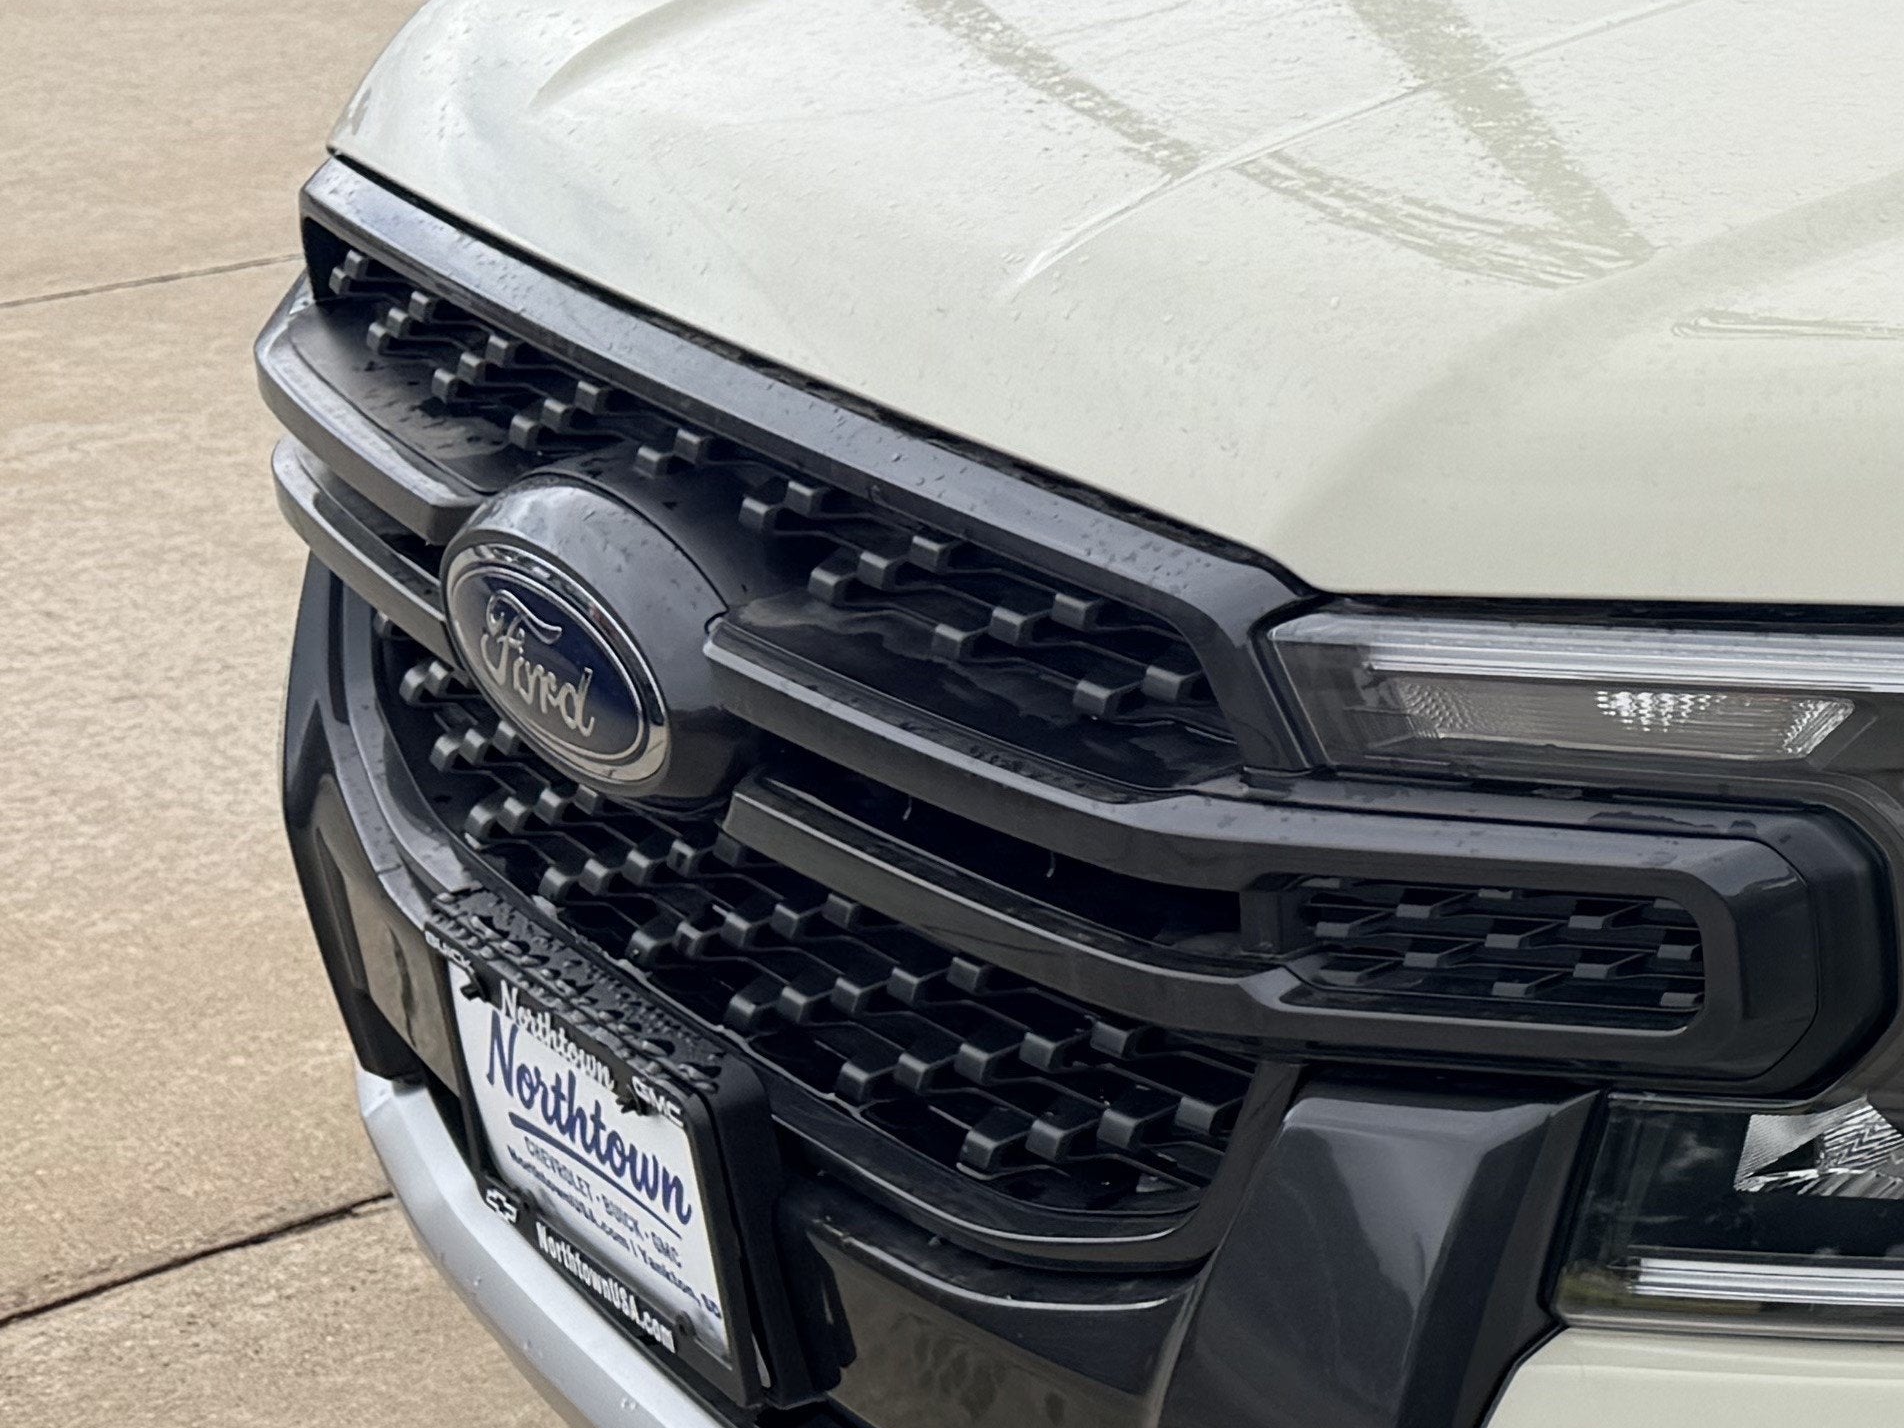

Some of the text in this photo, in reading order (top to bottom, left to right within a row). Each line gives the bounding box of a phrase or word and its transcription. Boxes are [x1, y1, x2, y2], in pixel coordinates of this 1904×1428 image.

[480, 589, 595, 737] Ford
[486, 1008, 692, 1225] Northtown
[500, 979, 684, 1128] Northtown GMC
[535, 1221, 676, 1354] NorthtownUSA.com
